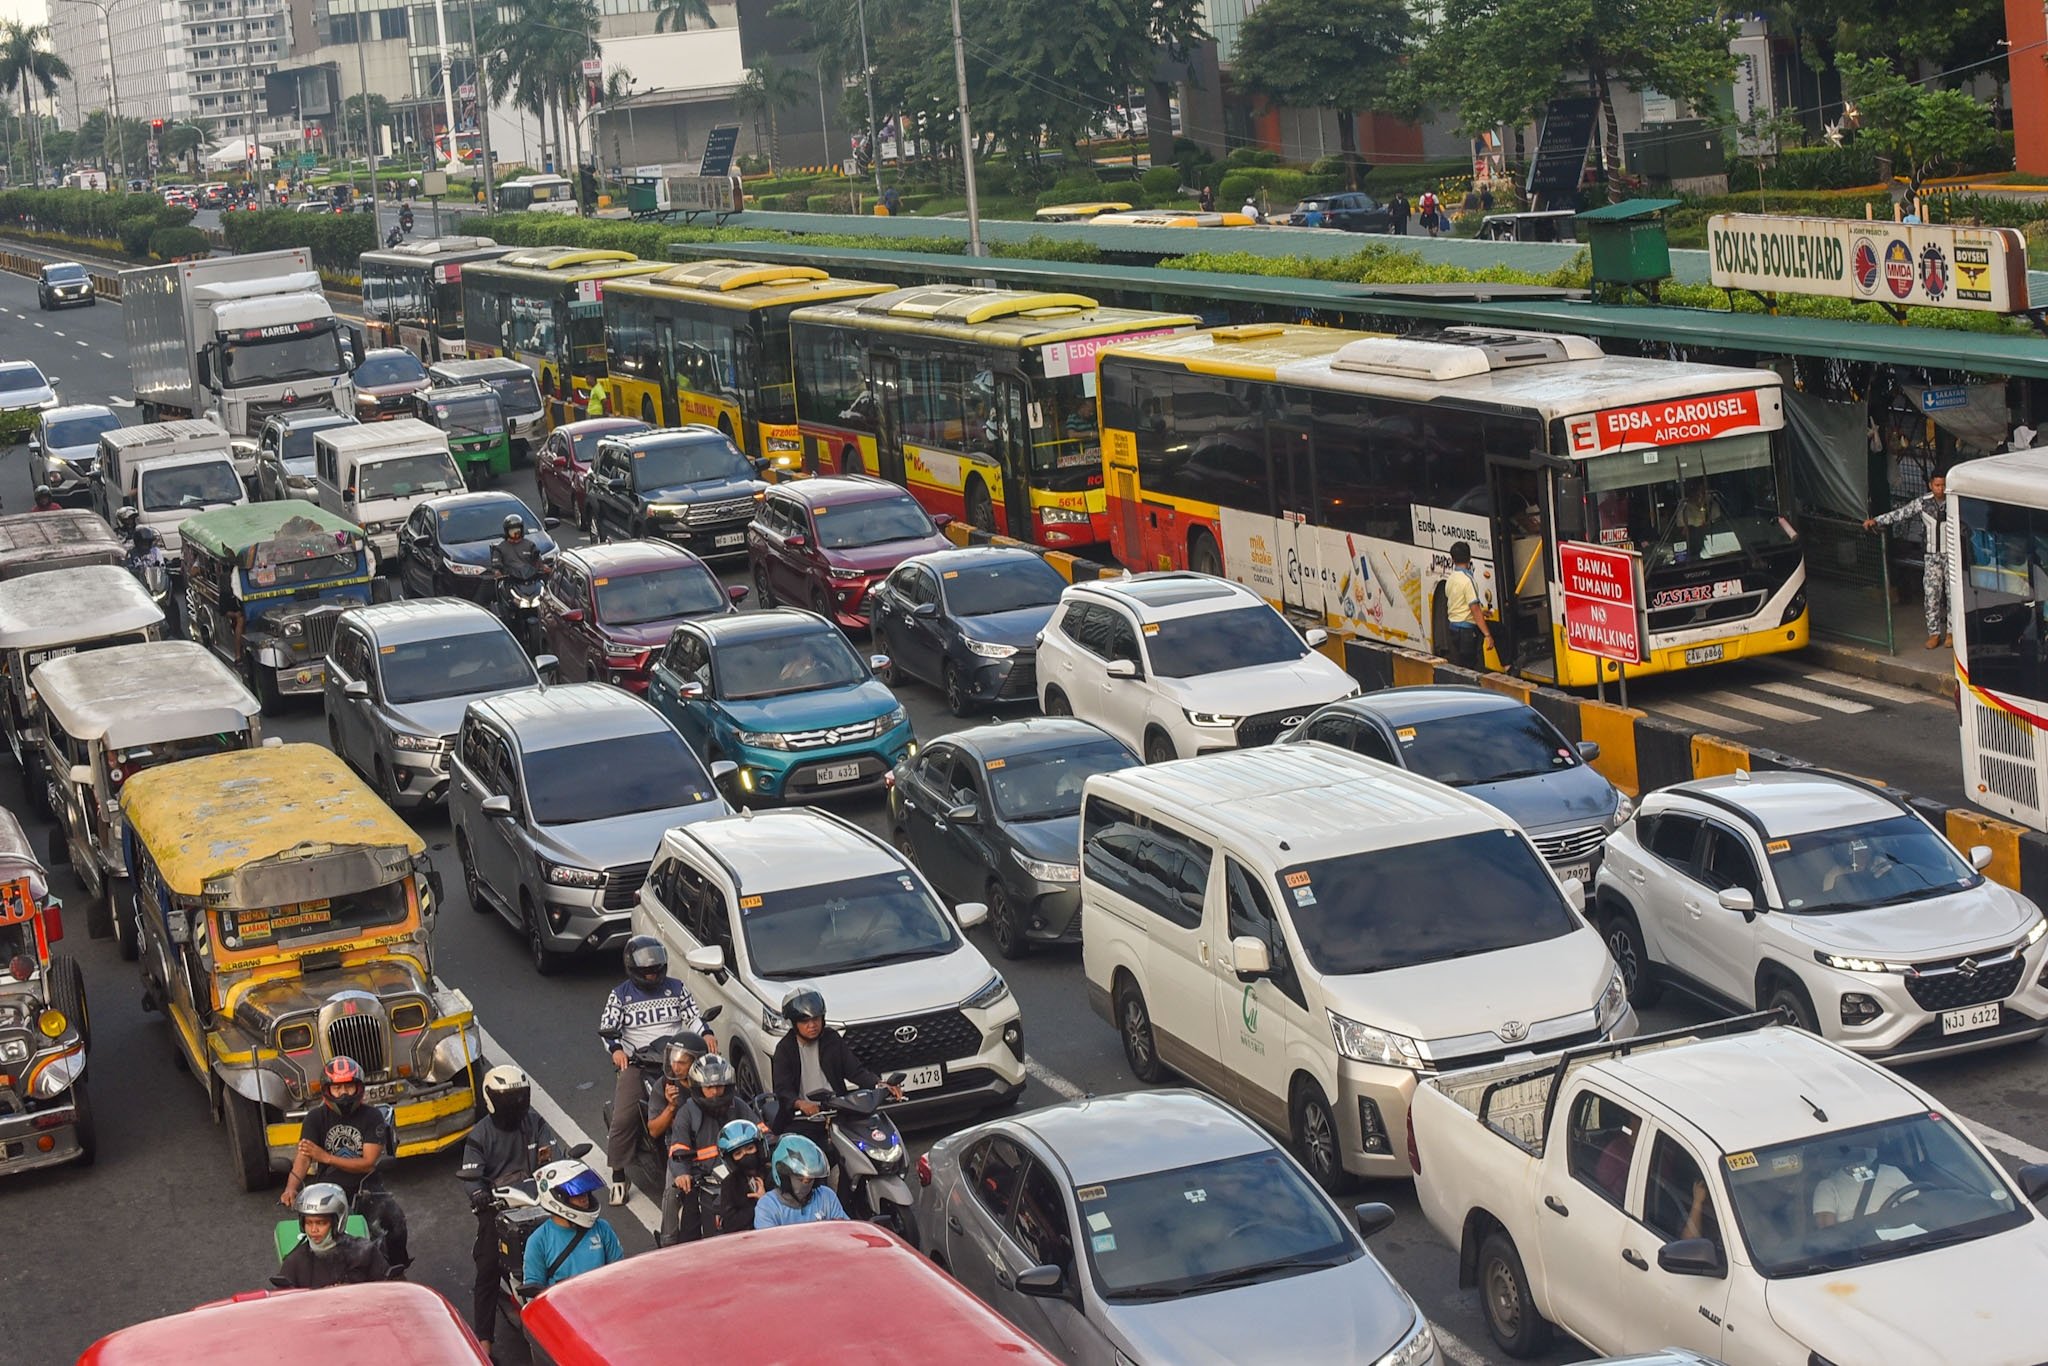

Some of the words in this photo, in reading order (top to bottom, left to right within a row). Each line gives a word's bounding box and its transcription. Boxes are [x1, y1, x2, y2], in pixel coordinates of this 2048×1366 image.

[1713, 230, 1758, 275] ROXAS
[1761, 232, 1844, 281] BOULEVARD
[1956, 250, 1987, 263] BOYSEN
[1887, 263, 1912, 279] MMDA
[260, 324, 300, 338] KAREILA
[1051, 347, 1060, 361] E
[331, 377, 339, 386] 7
[1571, 422, 1595, 451] E
[1608, 411, 1652, 433] EDSA
[1664, 398, 1747, 425] CAROUSEL
[1655, 423, 1711, 442] AIRCON
[1058, 497, 1083, 507] 5614
[1418, 521, 1437, 534] EDSA
[1442, 525, 1480, 542] CAROUSEL
[1249, 535, 1266, 550] milk
[1251, 550, 1273, 567] shake
[1577, 557, 1614, 578] BAWAL
[1572, 576, 1622, 599] TUMAWID
[1653, 584, 1713, 607] JASPER
[1591, 605, 1607, 623] NO
[1570, 621, 1635, 650] JAYWALKING
[30, 652, 47, 665] BIKE
[838, 766, 858, 778] 4321
[1566, 867, 1589, 879] 7997
[241, 923, 269, 934] ALABANG
[225, 960, 261, 971] LABANG
[1945, 1014, 1965, 1030] NJJ
[1972, 1008, 1997, 1024] 6122
[913, 1069, 940, 1085] 4178
[549, 1200, 578, 1219] EVO
